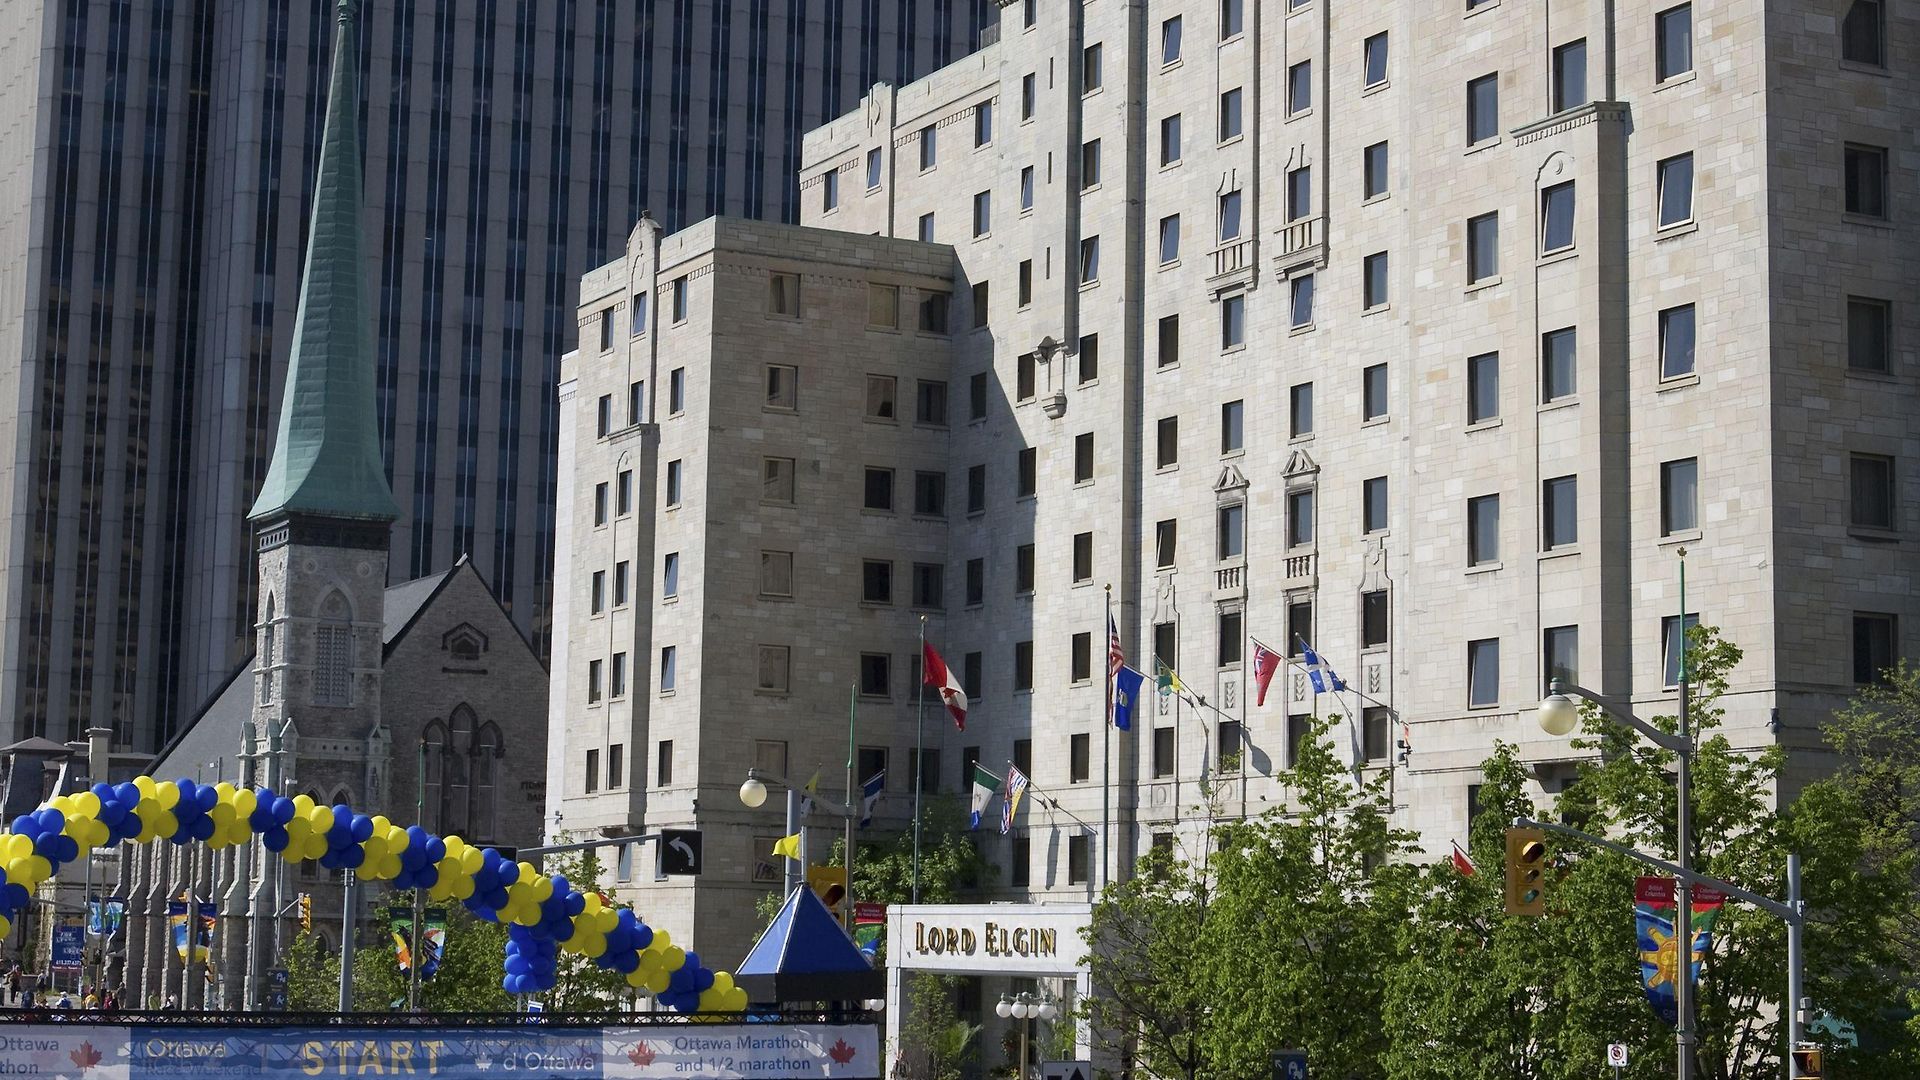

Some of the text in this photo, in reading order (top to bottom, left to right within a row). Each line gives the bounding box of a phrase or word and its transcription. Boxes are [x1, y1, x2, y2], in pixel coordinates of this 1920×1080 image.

[915, 922, 1057, 957] LORD ELGIN
[146, 1038, 226, 1058] Ottawa
[675, 1035, 809, 1050] Ottawa Marathon
[302, 1040, 445, 1076] START
[503, 1052, 595, 1071] d'Ottawa
[675, 1056, 811, 1072] and 1/2 marathon
